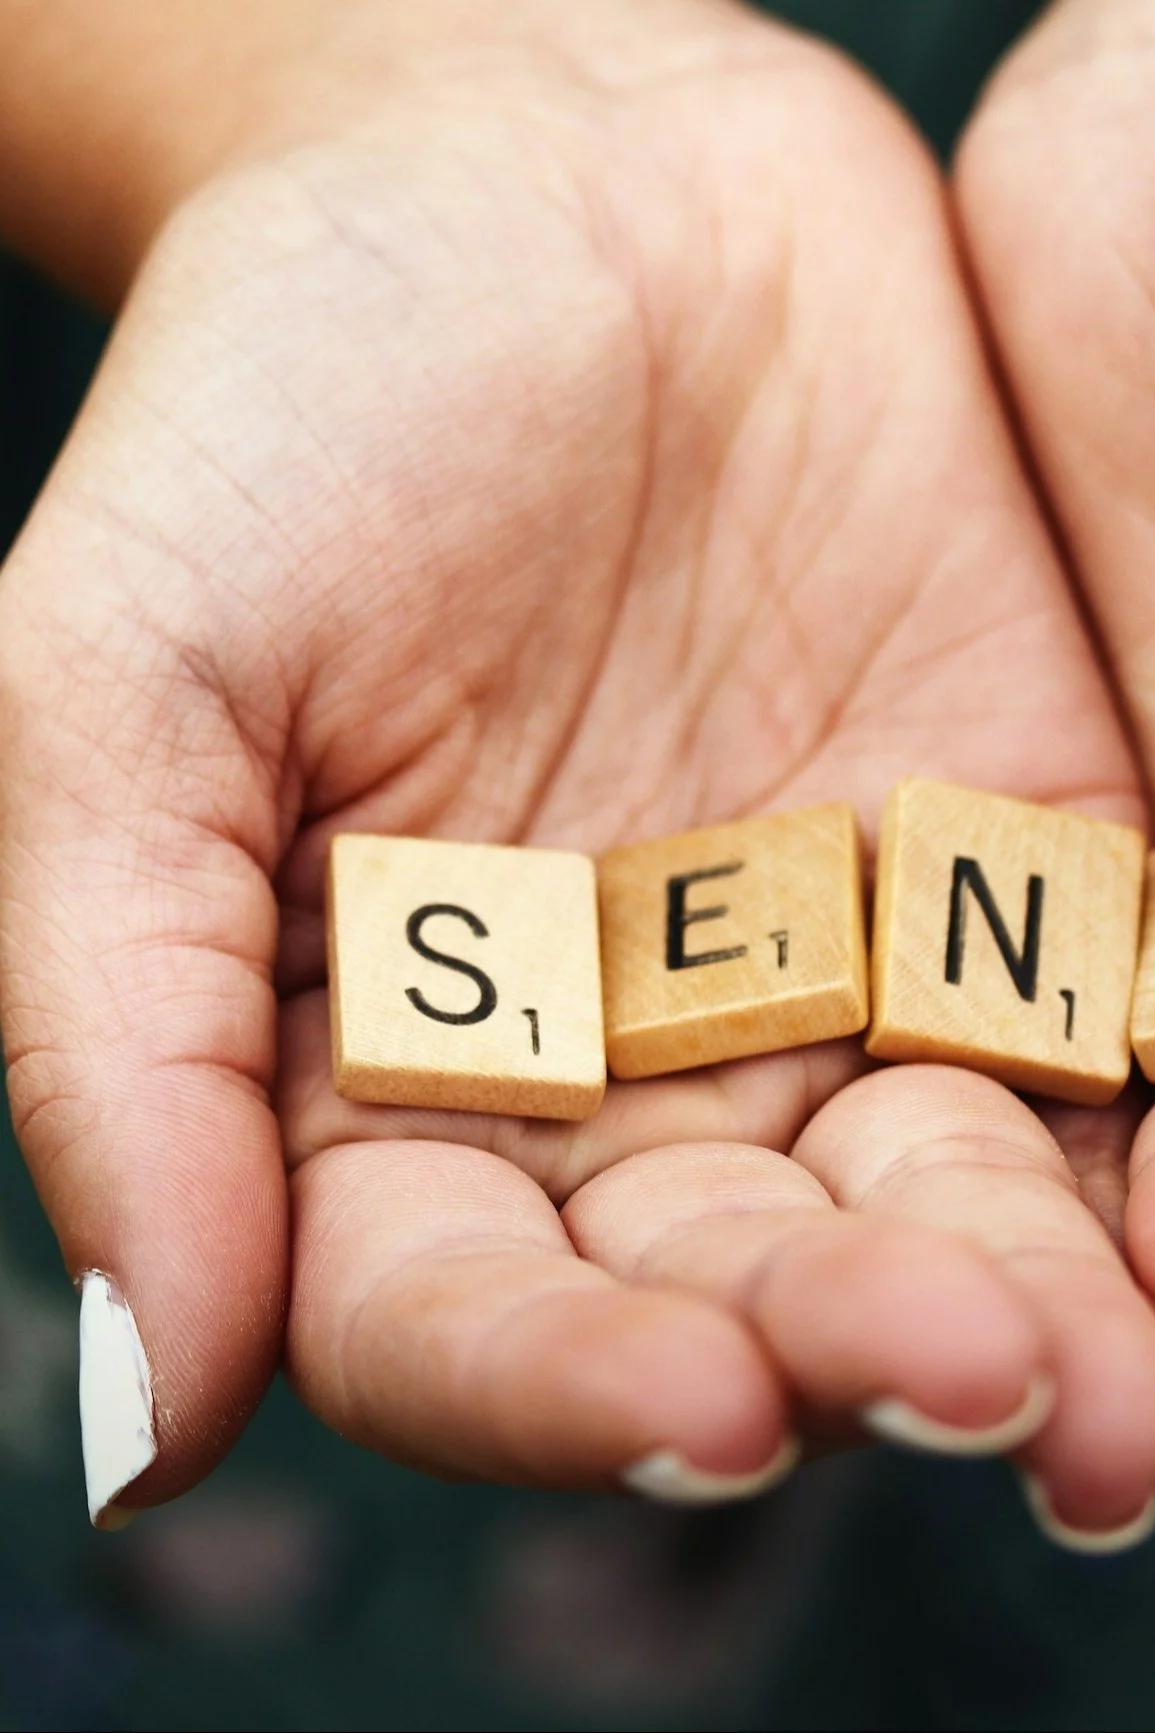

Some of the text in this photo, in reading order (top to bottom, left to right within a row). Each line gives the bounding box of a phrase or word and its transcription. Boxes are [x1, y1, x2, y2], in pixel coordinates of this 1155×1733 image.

[769, 930, 789, 970] 1
[522, 1007, 541, 1055] 1
[1058, 988, 1076, 1042] 1
